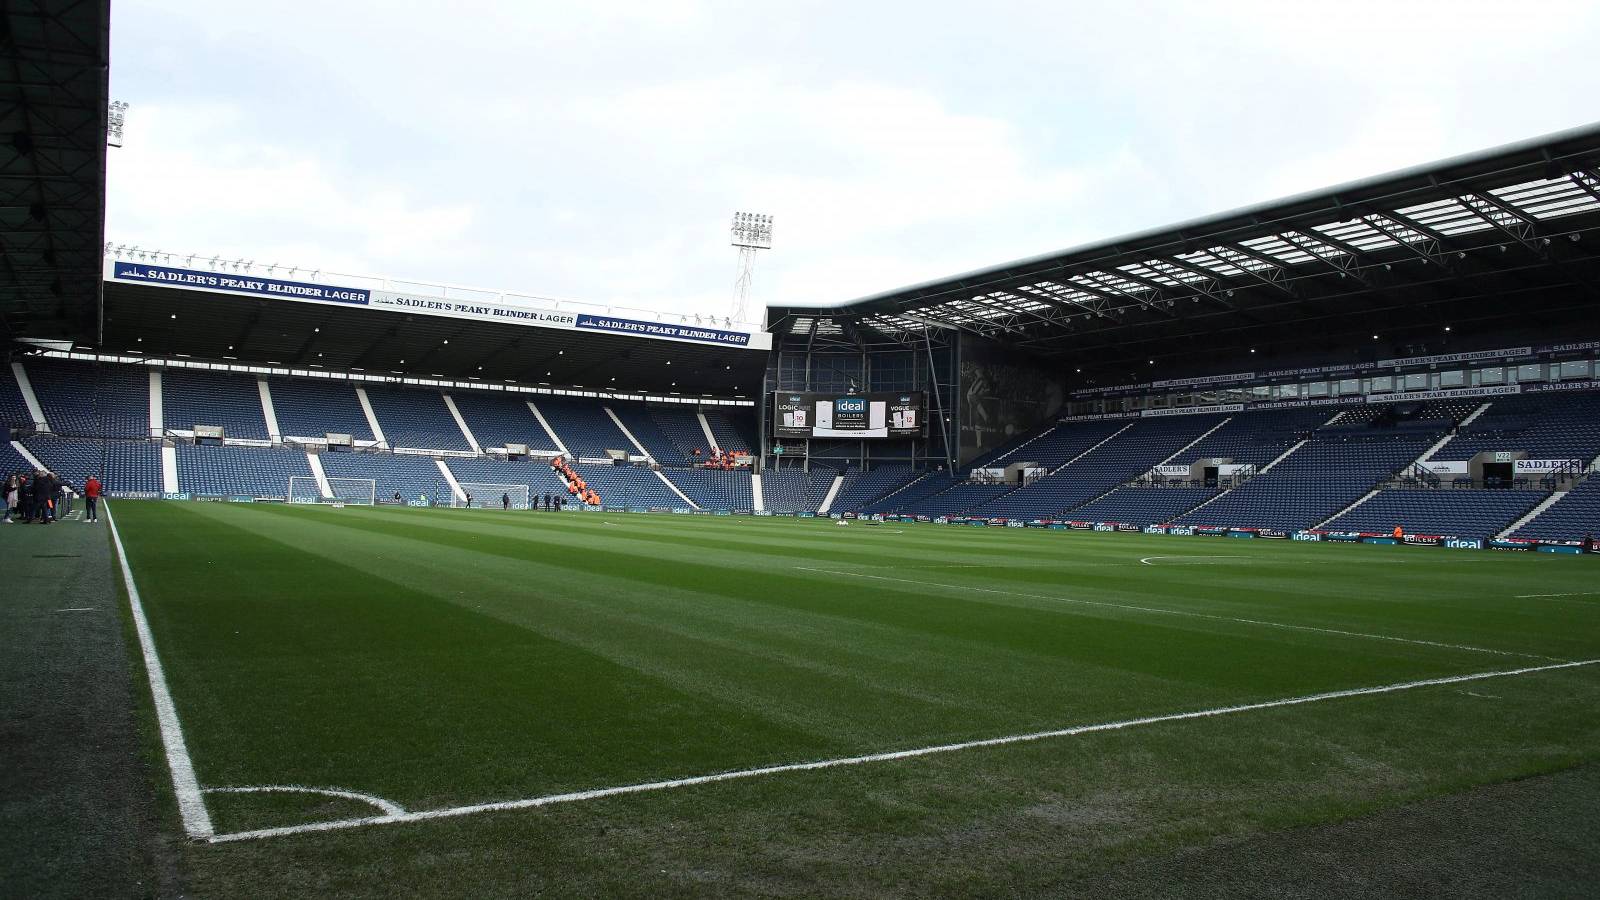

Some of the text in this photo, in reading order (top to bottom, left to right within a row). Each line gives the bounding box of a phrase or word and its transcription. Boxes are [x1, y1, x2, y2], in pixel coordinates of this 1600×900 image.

[148, 270, 365, 302] SADLER'S PEAKY BLINDER LAGER
[396, 298, 574, 324] SADLER'S PEAKY BLINDER LAGER
[598, 320, 747, 343] SADLER'S PEAKY BLINDER LAGER
[1553, 341, 1600, 352] SADLER'S
[1394, 357, 1431, 366] SADLER'S
[1461, 352, 1496, 360] BLINDER
[1498, 349, 1526, 357] LAGER
[1268, 368, 1298, 377] SADLER'S
[1322, 364, 1350, 373] BLINDER
[1542, 382, 1589, 391] SADLER'S
[1384, 392, 1420, 401] SADLER'S
[838, 401, 864, 410] ideal
[1144, 526, 1165, 534] ideal
[1171, 527, 1192, 535] ideal
[1293, 532, 1320, 541] ideal
[1447, 540, 1481, 549] ideal
